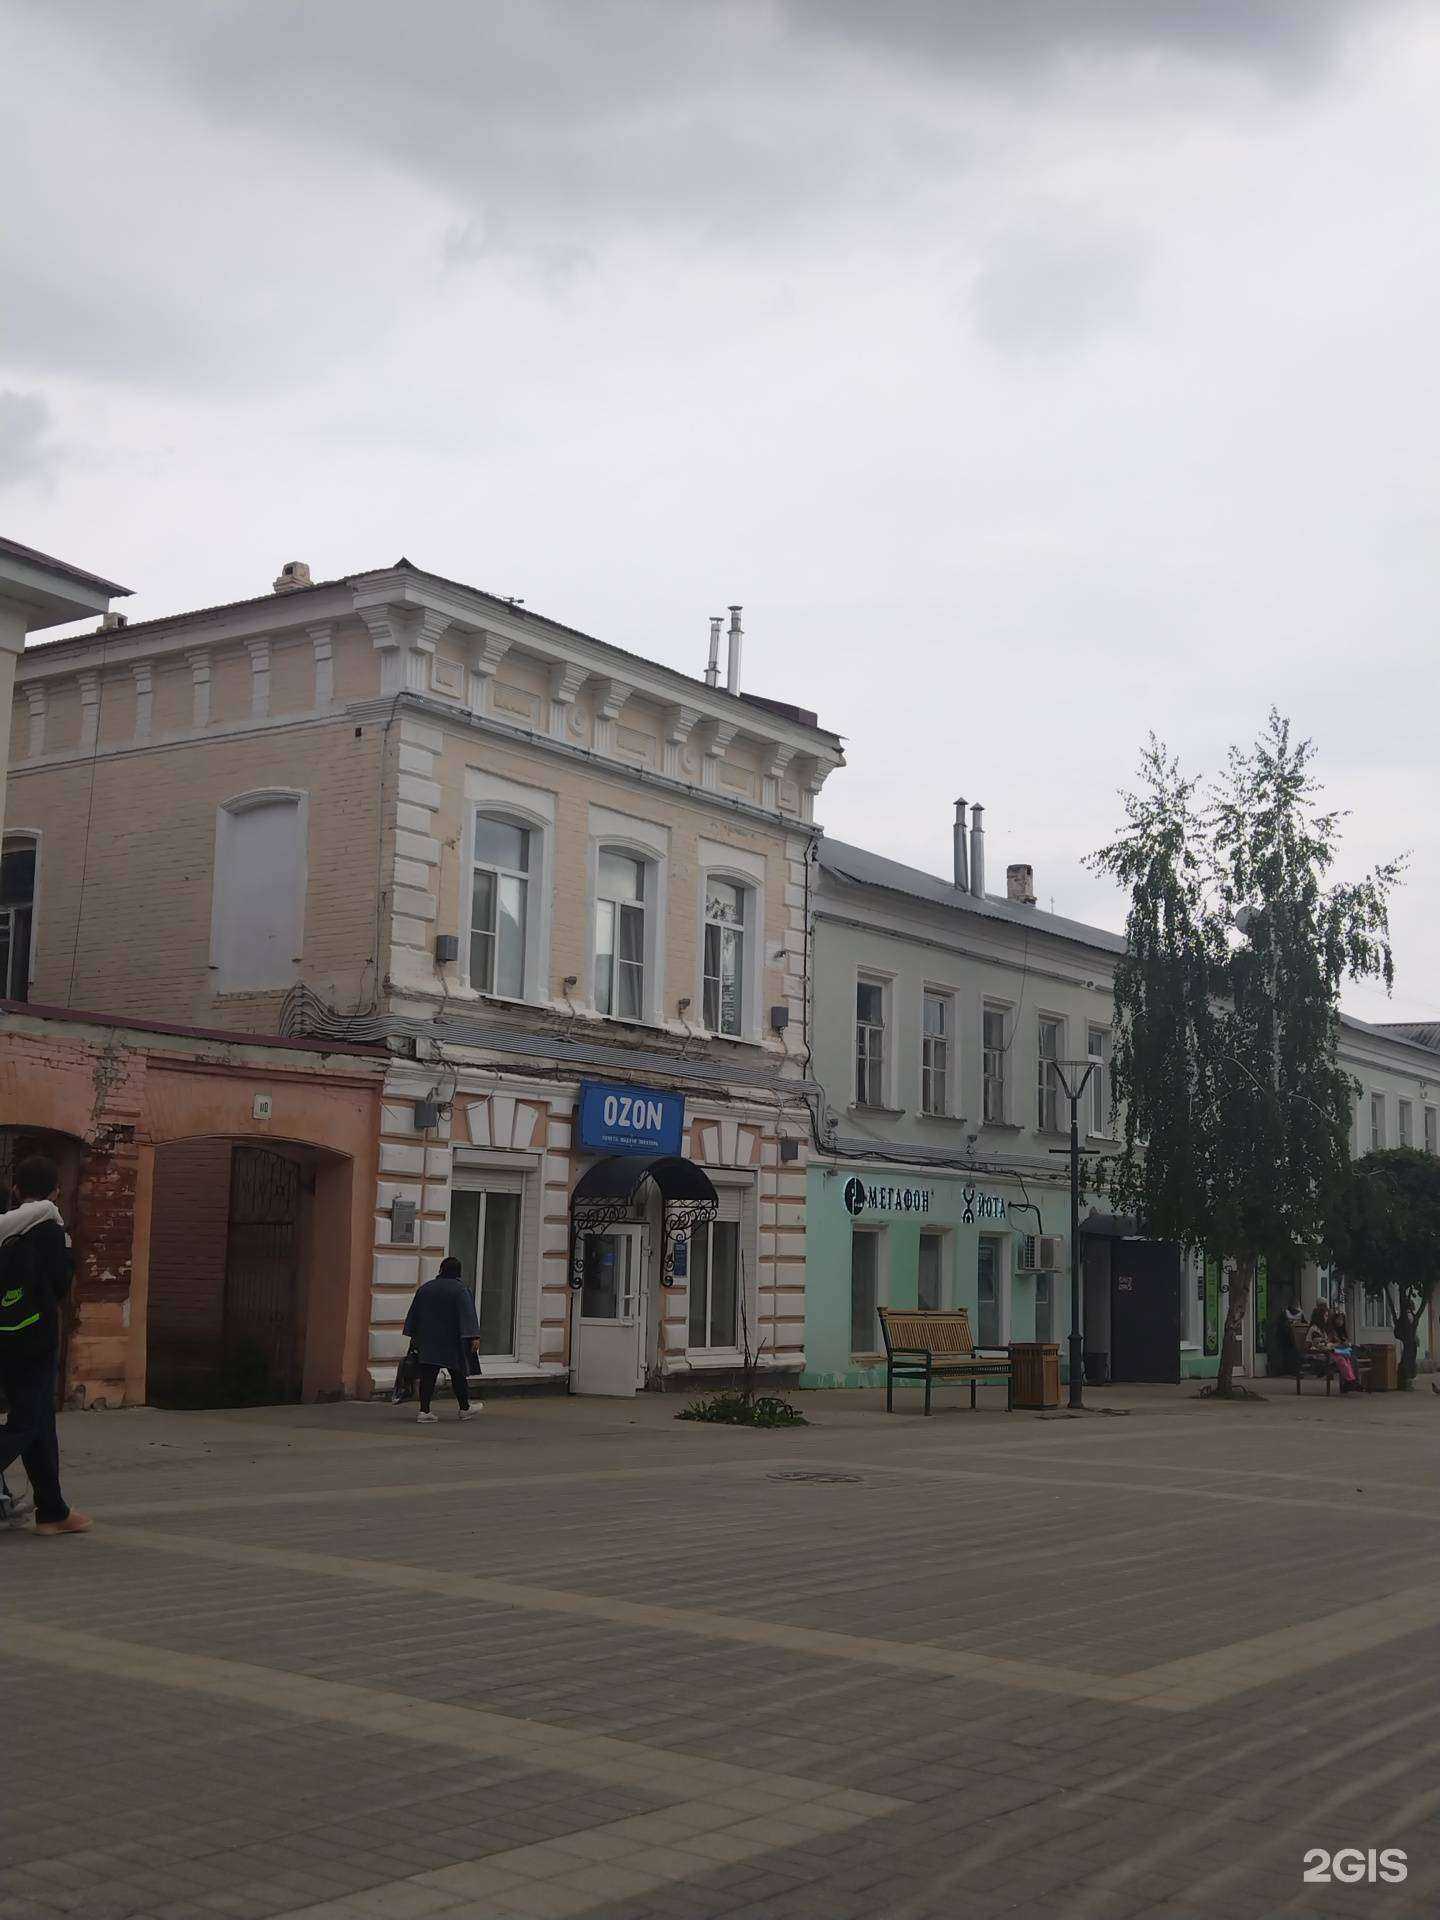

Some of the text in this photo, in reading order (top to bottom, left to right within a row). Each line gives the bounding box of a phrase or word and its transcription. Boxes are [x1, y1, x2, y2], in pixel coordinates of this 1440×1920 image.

[604, 1095, 663, 1130] OZON
[868, 1186, 930, 1213] МЕГАФОН
[977, 1192, 1007, 1218] ЙОТА
